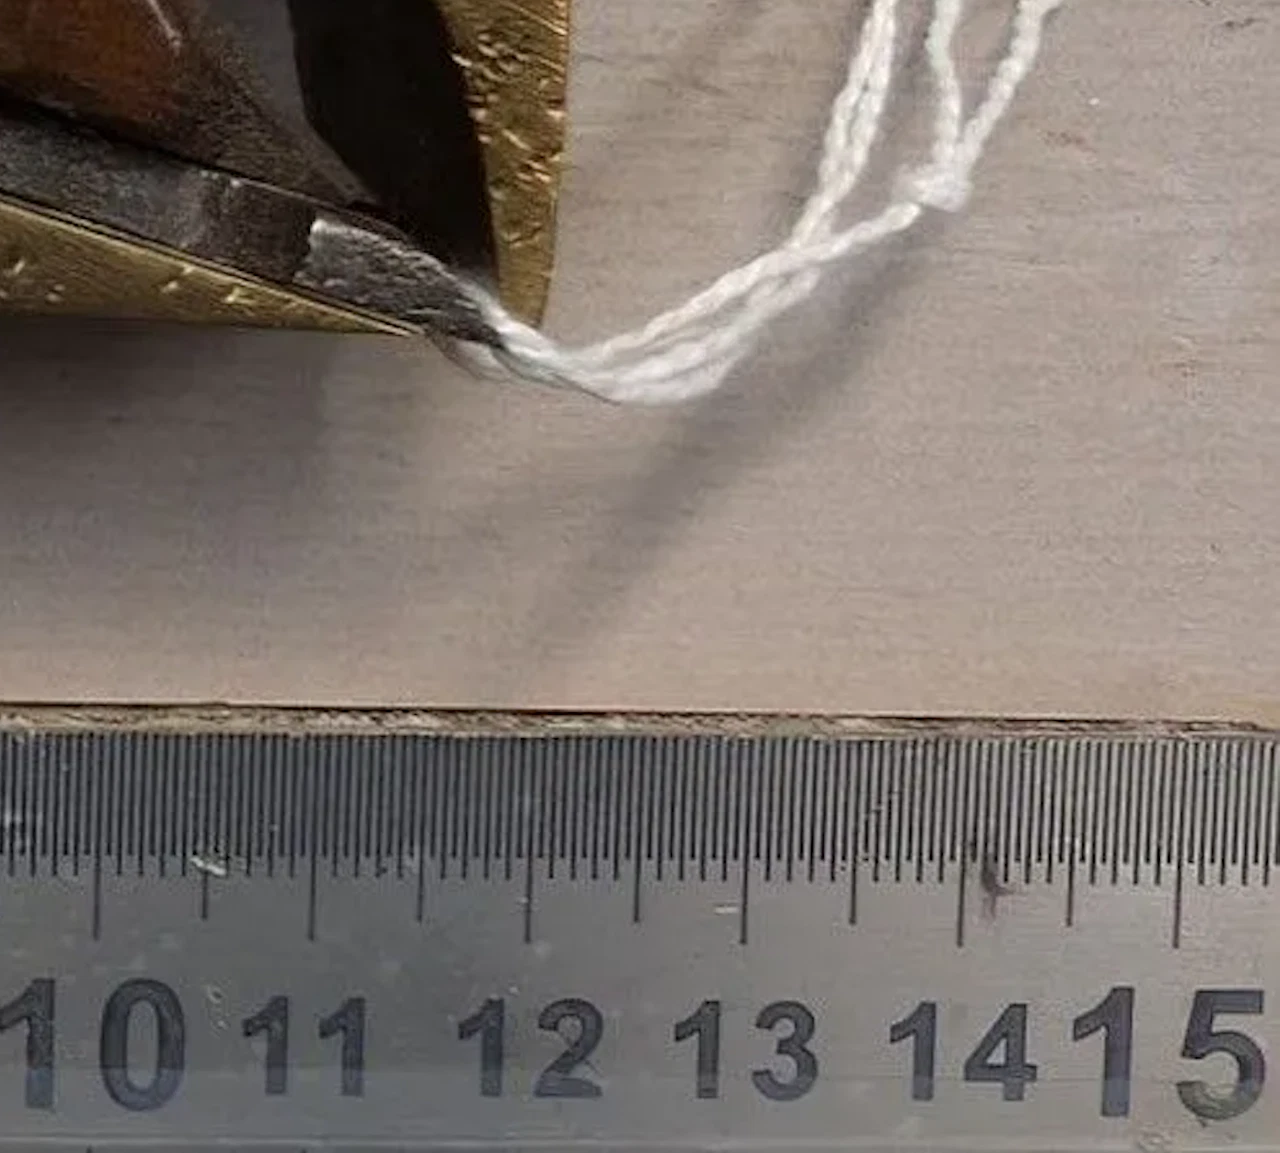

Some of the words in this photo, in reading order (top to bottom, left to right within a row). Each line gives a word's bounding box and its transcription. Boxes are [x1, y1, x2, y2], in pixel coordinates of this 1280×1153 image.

[243, 995, 366, 1097] 11
[457, 998, 604, 1099] 12
[673, 1000, 820, 1101] 13
[889, 1001, 1039, 1102] 14
[1072, 986, 1266, 1121] 15
